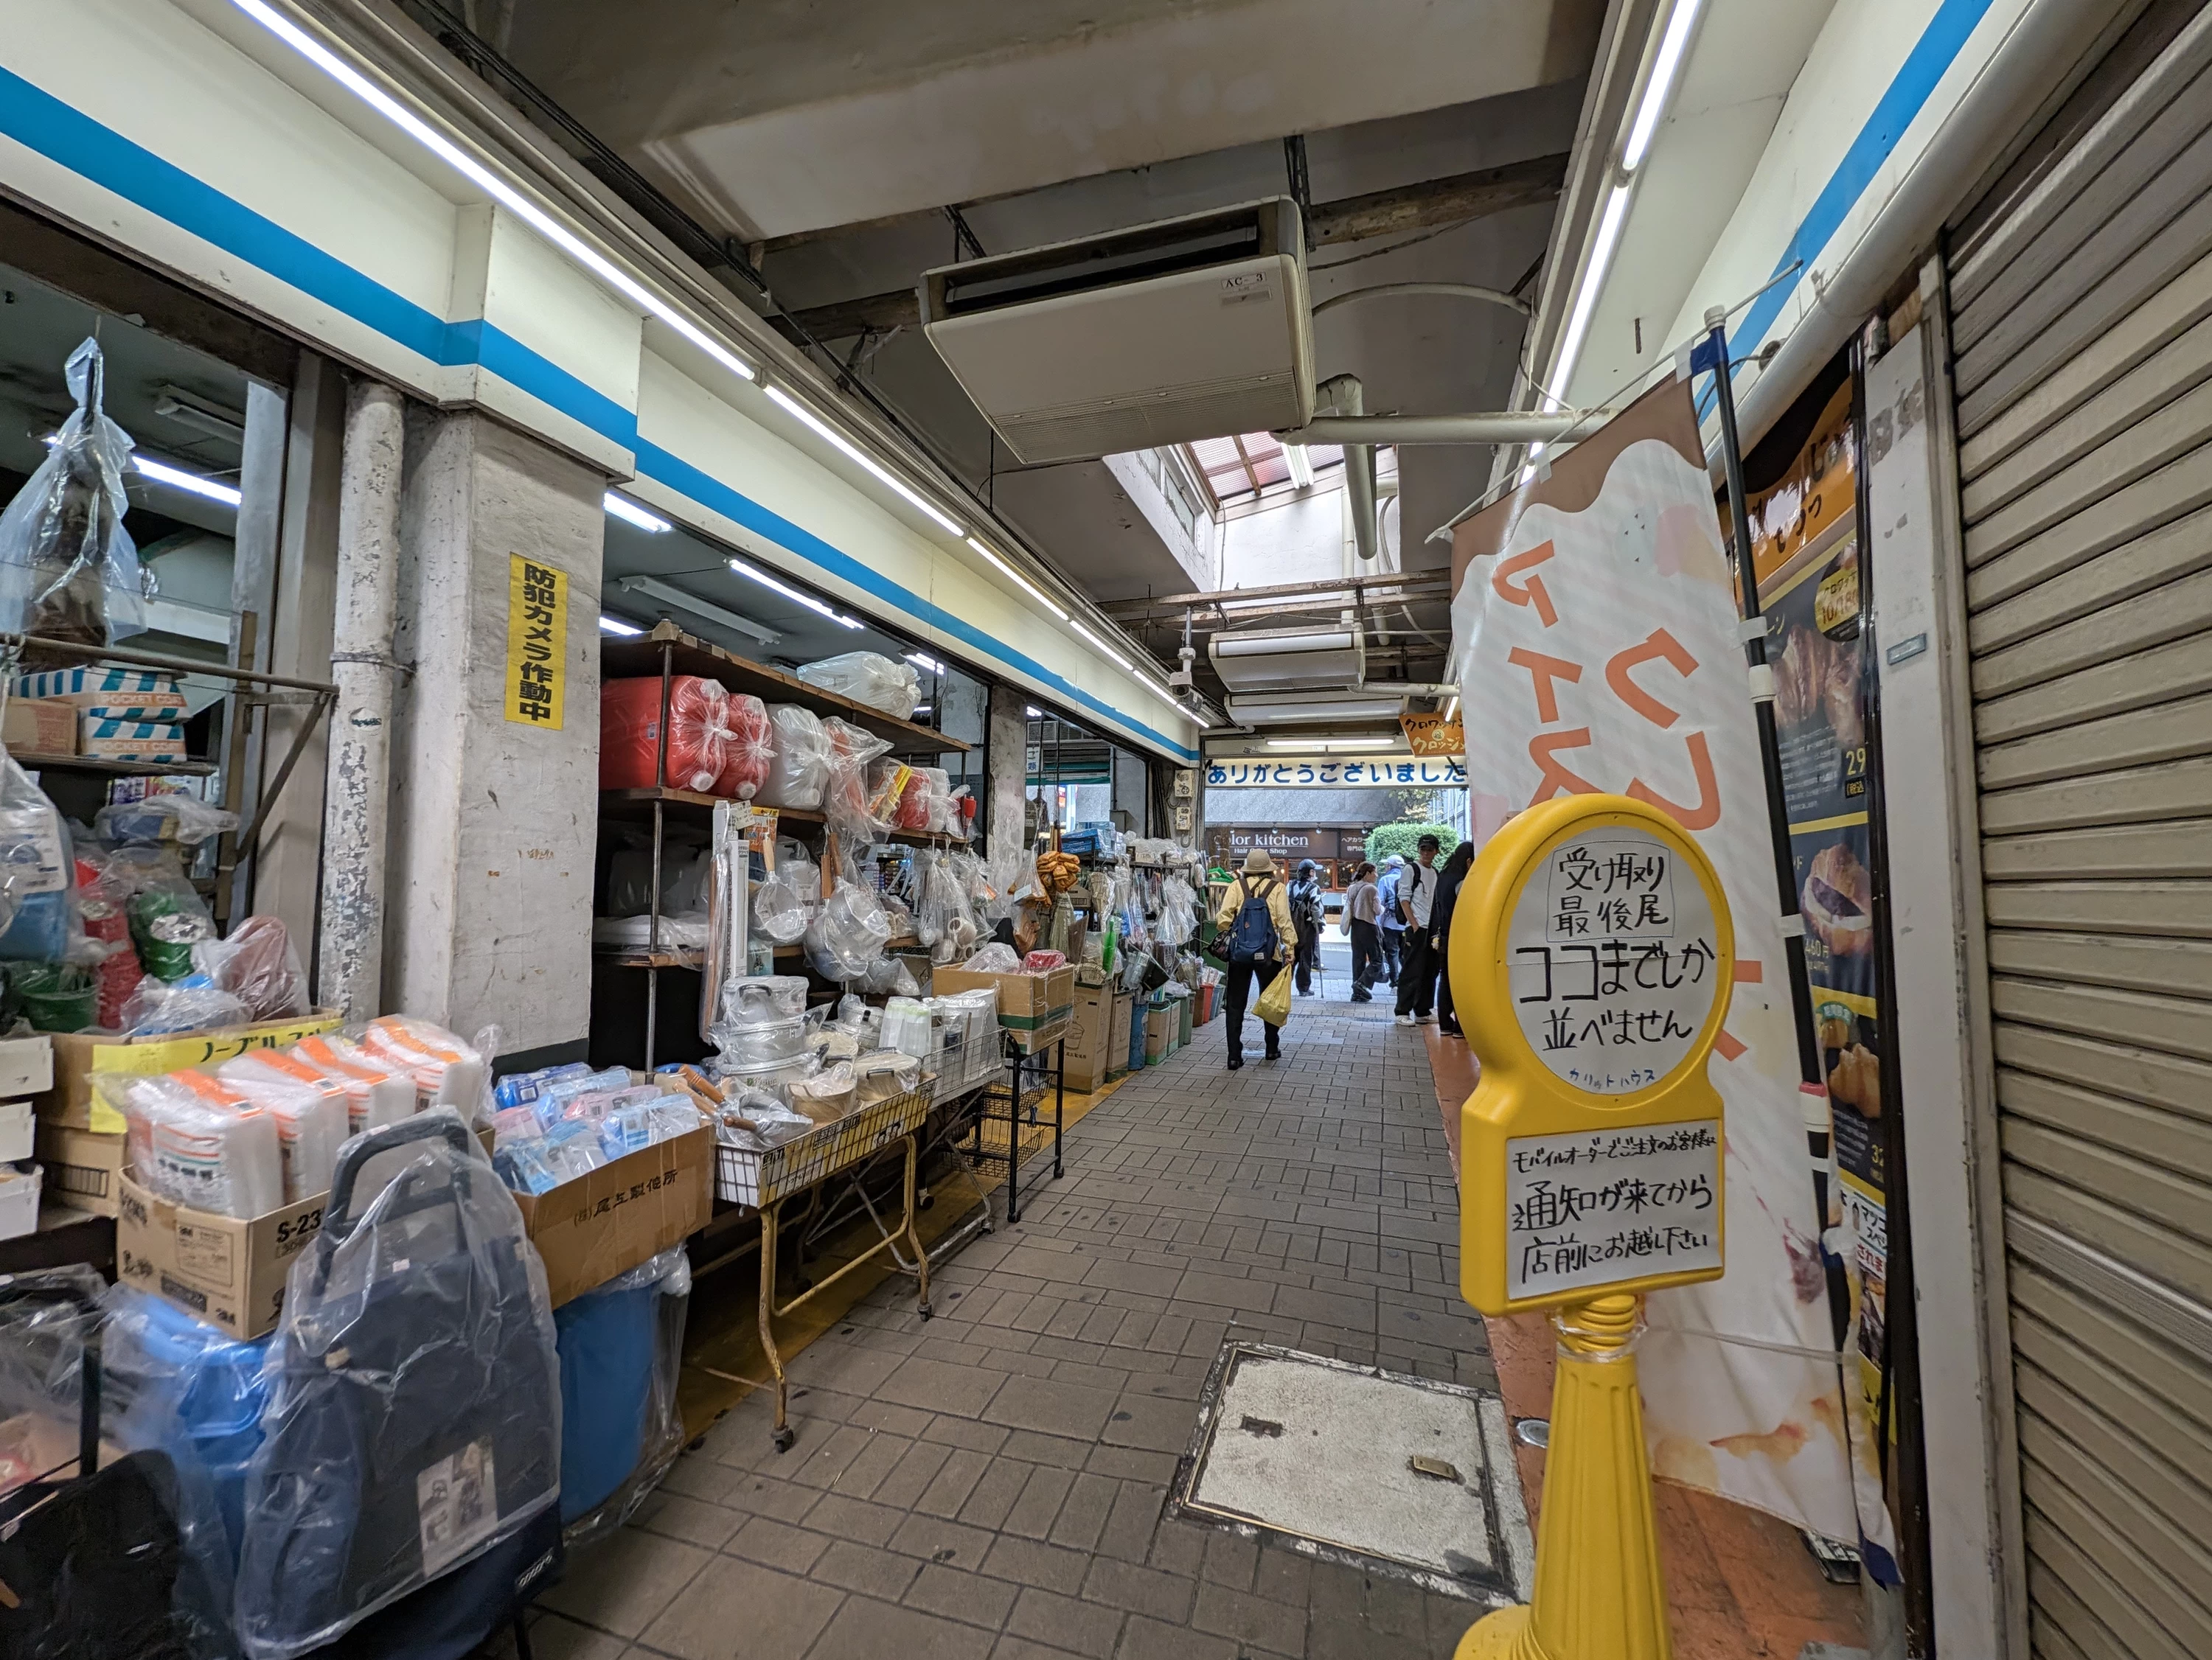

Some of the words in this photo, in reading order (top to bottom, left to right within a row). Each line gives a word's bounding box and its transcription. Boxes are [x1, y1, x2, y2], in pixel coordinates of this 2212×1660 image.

[519, 563, 556, 721] 防犯カメラ作動中
[1208, 761, 1466, 784] ありがとうございました
[1255, 834, 1309, 846] kitchen
[1559, 847, 1664, 893] 受け取り
[1553, 894, 1669, 937] 最後尾
[1516, 938, 1715, 1003] ココまでしか
[1543, 1006, 1693, 1051] 並べません
[1512, 1174, 1713, 1231] 通知が来てから
[1521, 1225, 1708, 1285] 店前にお越し下さい
